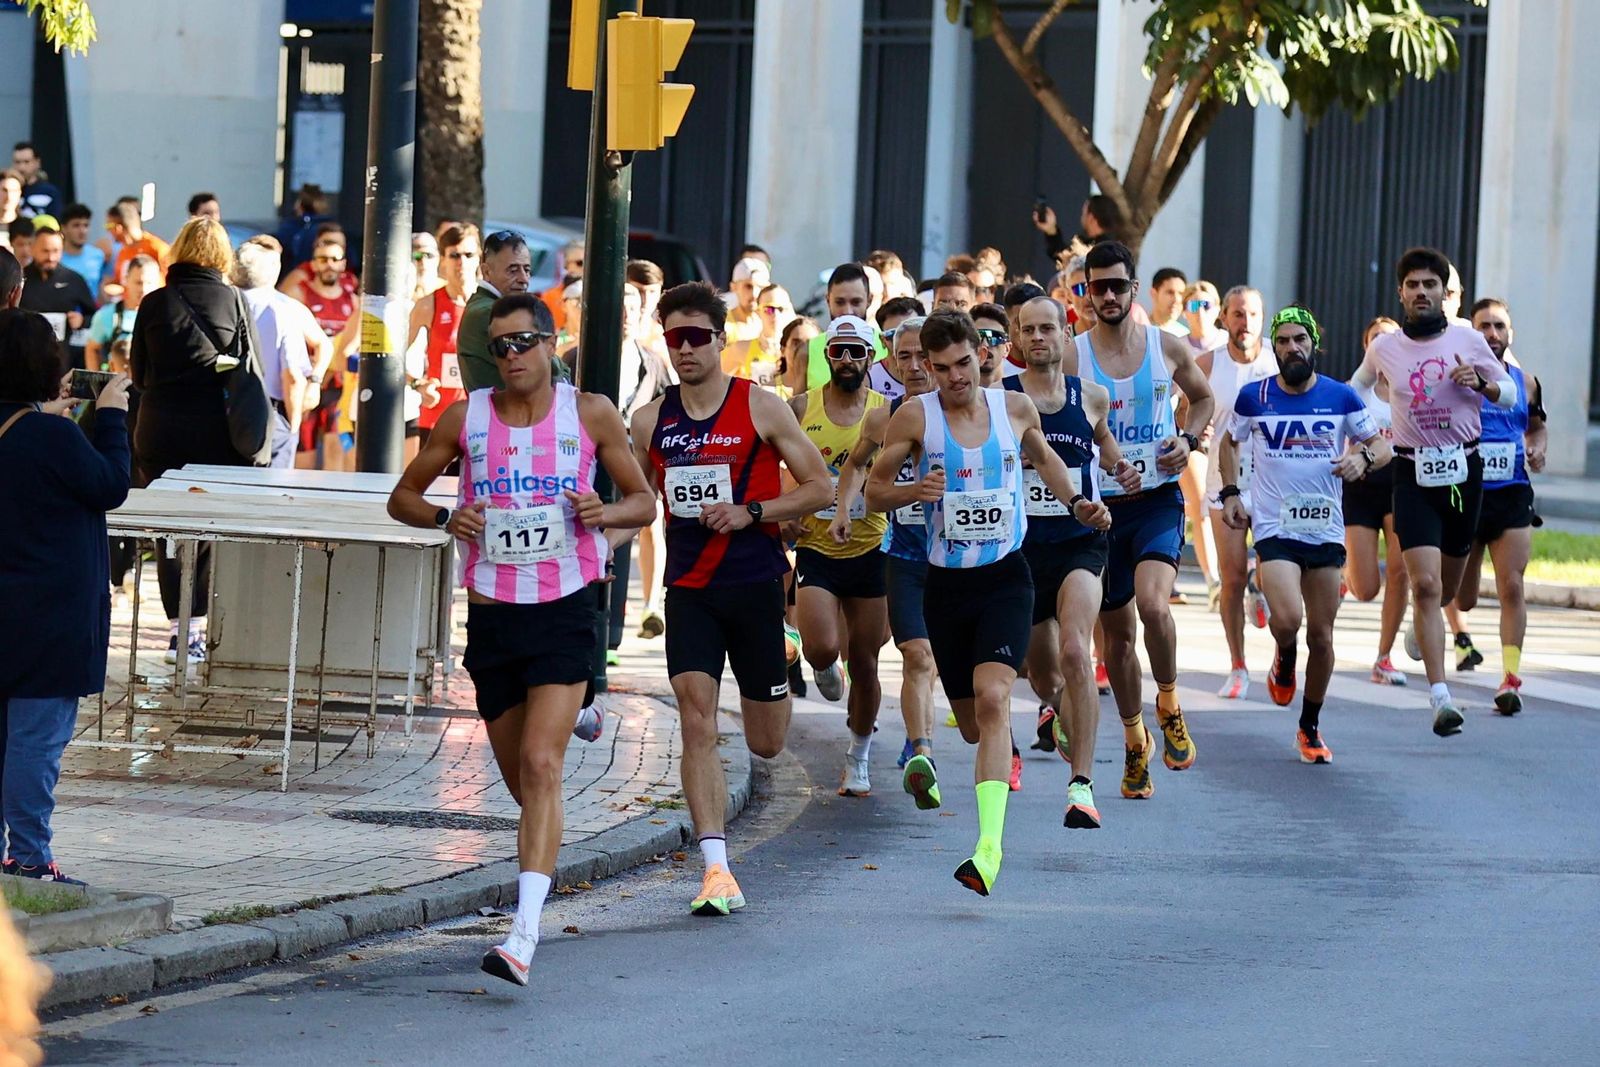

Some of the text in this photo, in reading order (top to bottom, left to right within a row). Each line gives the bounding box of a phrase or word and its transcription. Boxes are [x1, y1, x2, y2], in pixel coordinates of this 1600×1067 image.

[661, 432, 742, 449] RFC Liège
[1258, 420, 1335, 451] VAS
[1422, 459, 1459, 475] 324
[673, 483, 719, 502] 694
[955, 507, 1002, 526] 330
[1289, 507, 1330, 520] 1029
[497, 526, 550, 548] 117
